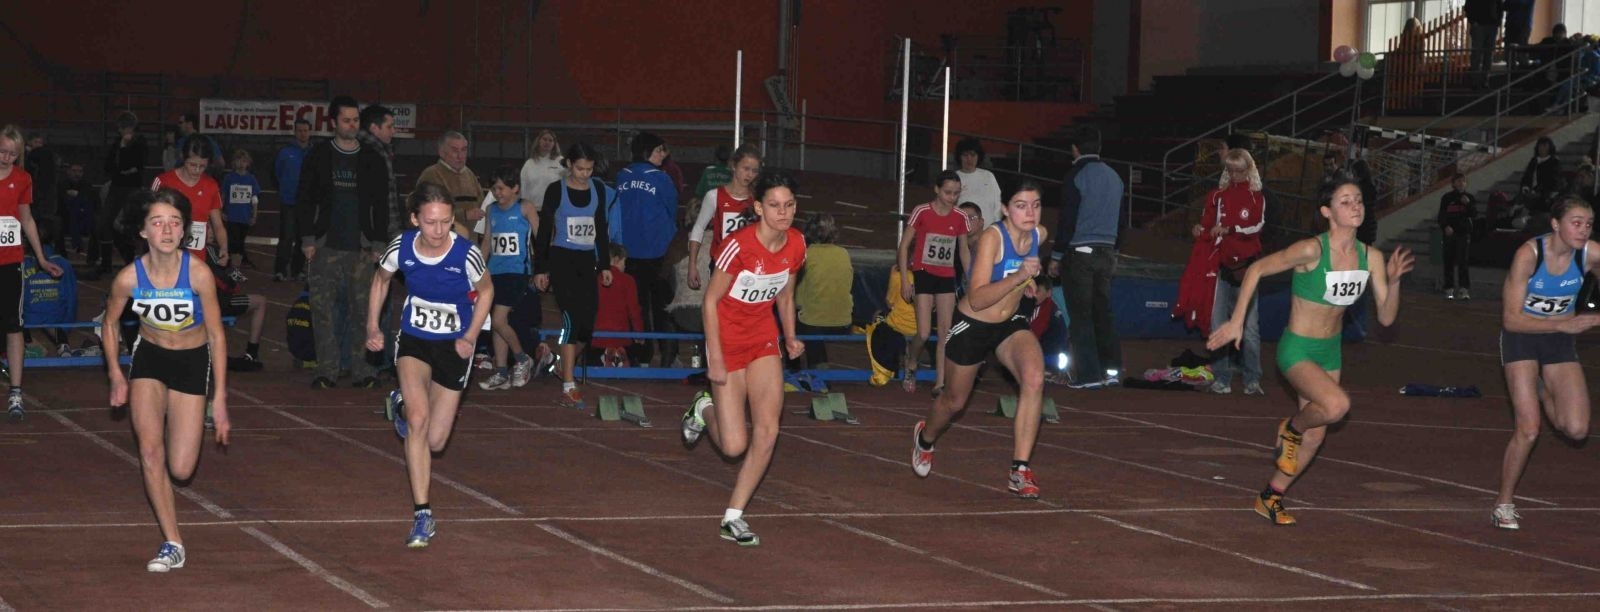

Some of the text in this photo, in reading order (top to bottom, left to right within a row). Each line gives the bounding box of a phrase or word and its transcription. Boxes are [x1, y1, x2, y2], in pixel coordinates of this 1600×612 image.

[204, 104, 336, 131] LAUSITZ ECH
[630, 180, 658, 197] RIESA
[568, 224, 594, 236] 1272
[725, 218, 747, 234] 20
[0, 231, 15, 244] 68
[187, 235, 200, 248] 21
[492, 236, 517, 253] 795
[927, 244, 952, 261] 586
[741, 286, 778, 302] 1018
[1332, 281, 1362, 297] 1321
[136, 302, 191, 323] 705
[414, 305, 458, 331] 534
